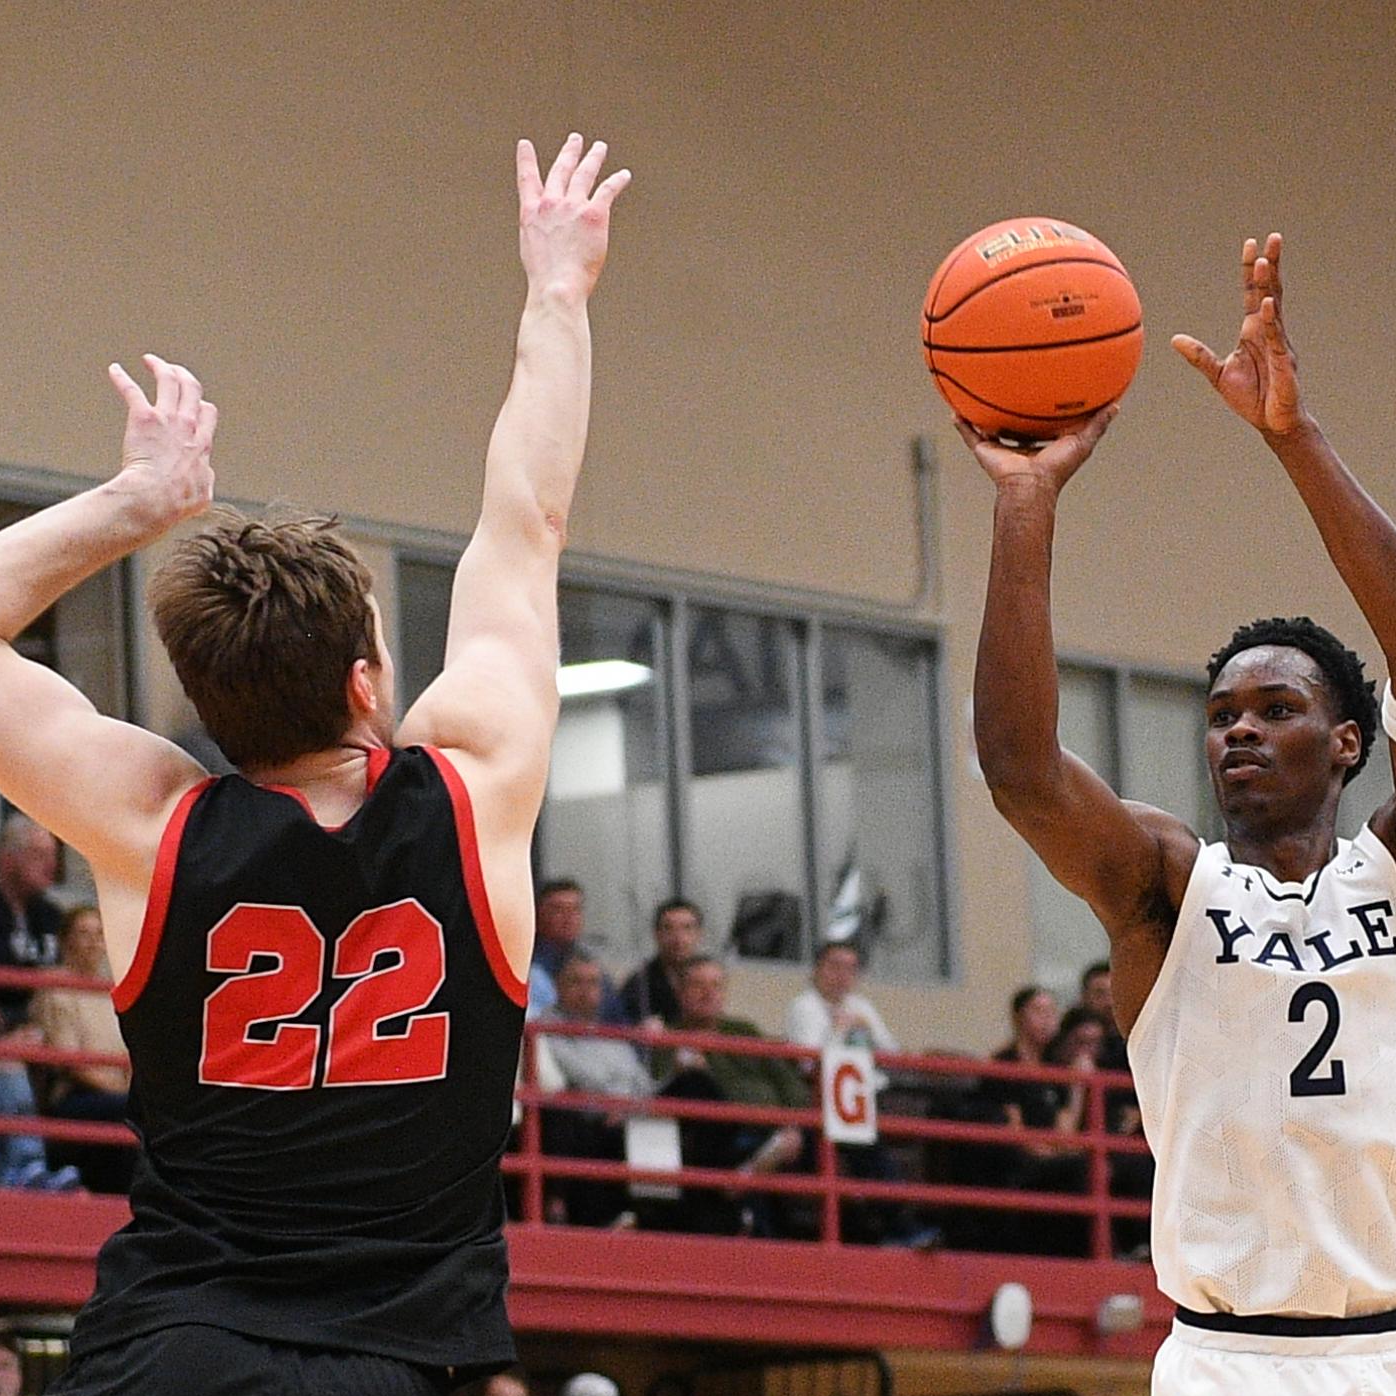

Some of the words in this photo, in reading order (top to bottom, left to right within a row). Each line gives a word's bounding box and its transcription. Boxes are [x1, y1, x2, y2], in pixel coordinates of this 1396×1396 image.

[198, 897, 451, 1091] 22
[1287, 981, 1346, 1098] 2
[834, 1064, 867, 1125] G
